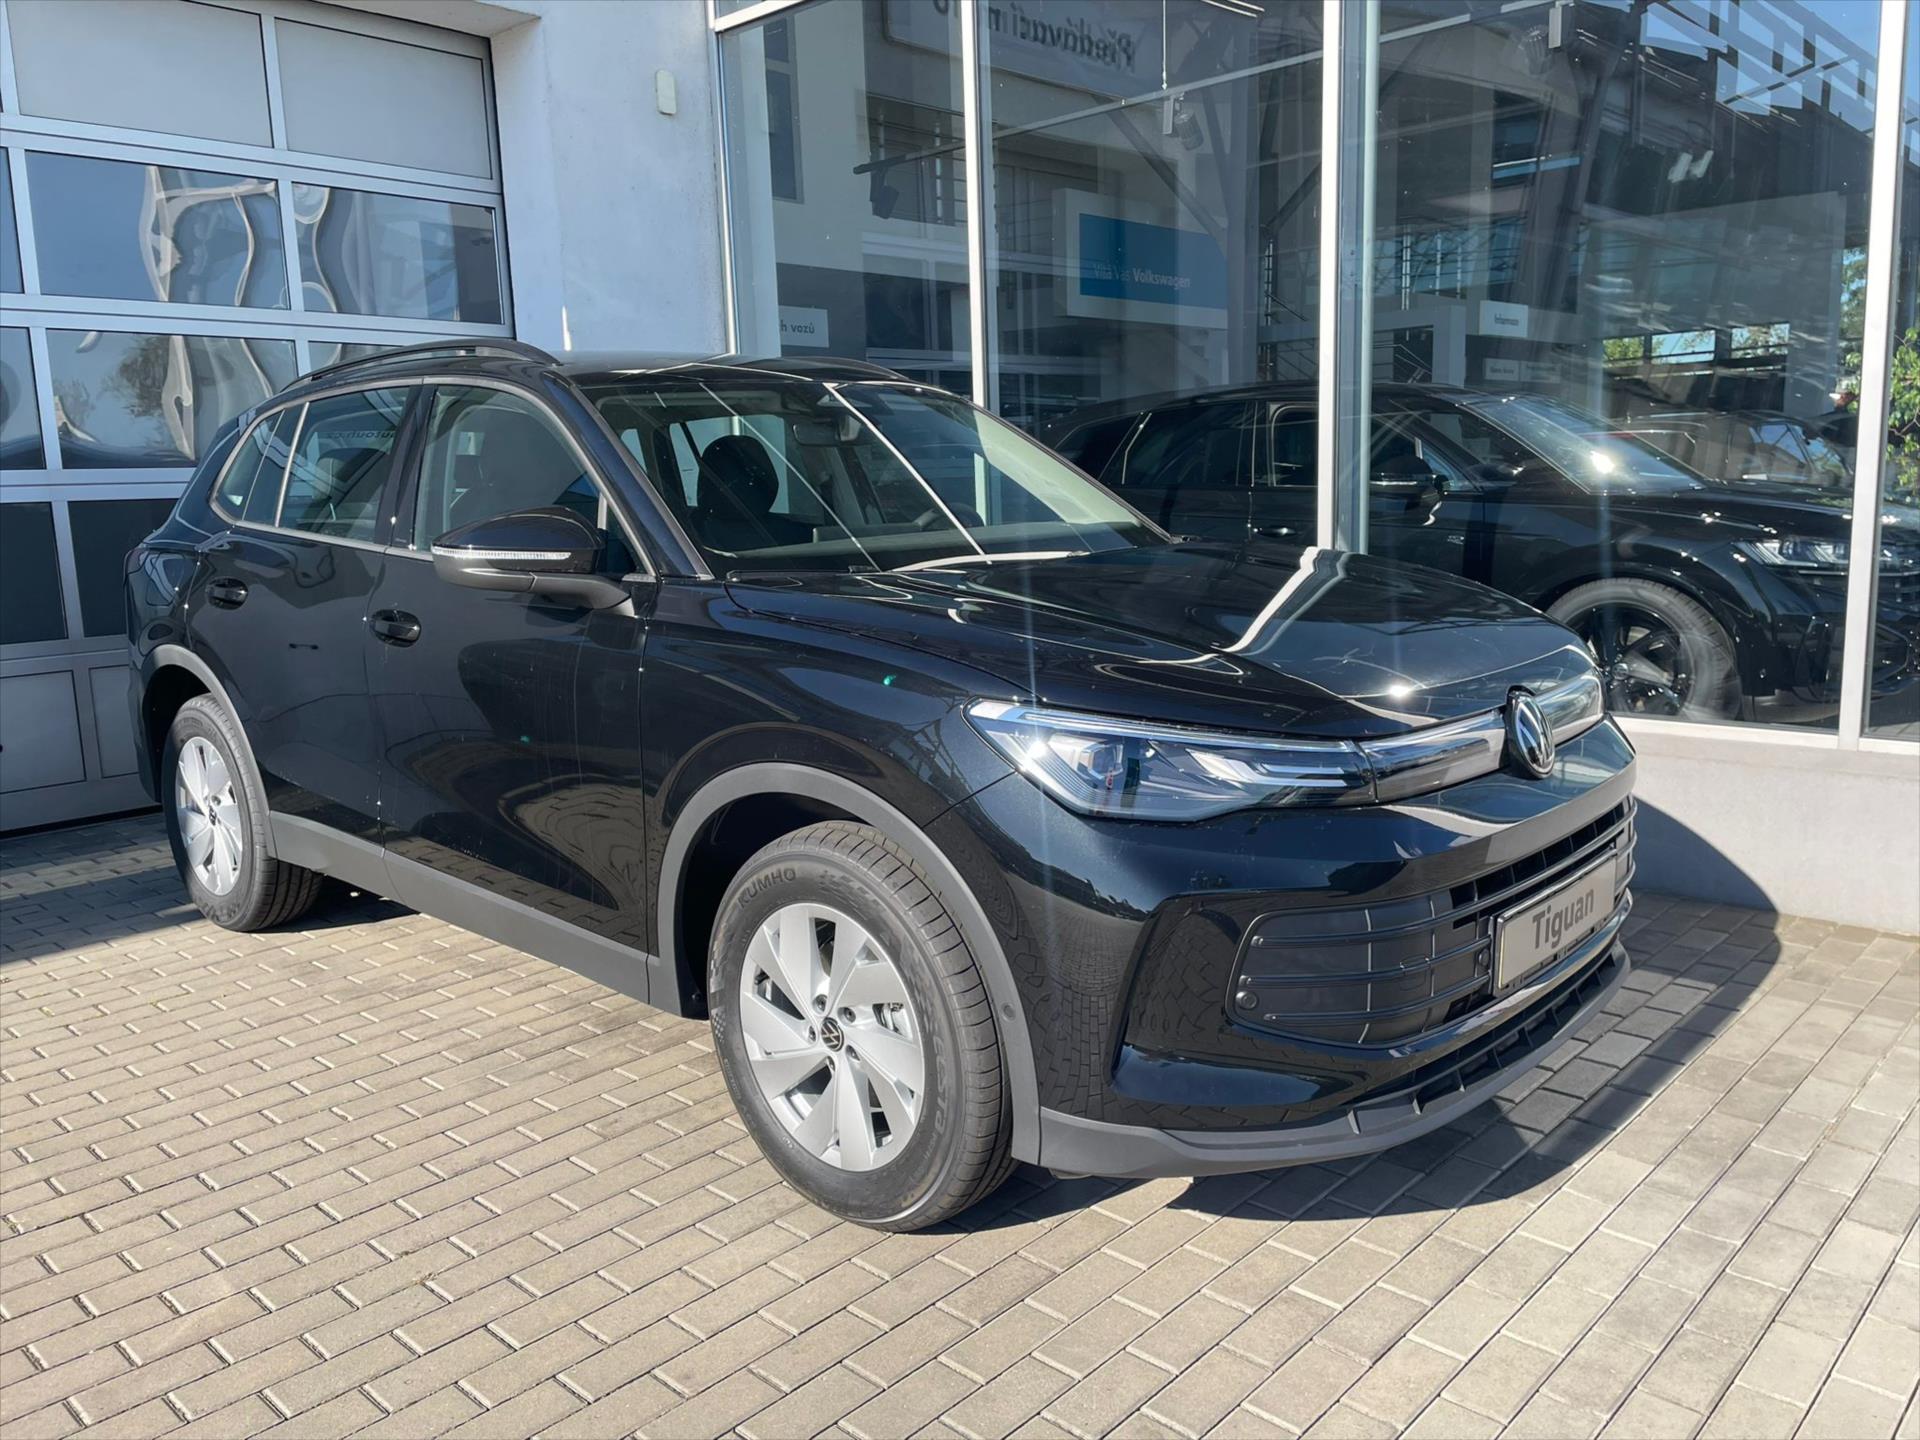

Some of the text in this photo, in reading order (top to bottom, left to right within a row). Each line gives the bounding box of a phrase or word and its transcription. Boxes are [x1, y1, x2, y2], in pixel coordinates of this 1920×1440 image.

[1133, 268, 1192, 289] Volkswagen
[737, 867, 797, 908] KUMHO
[1532, 888, 1595, 949] Tiguan
